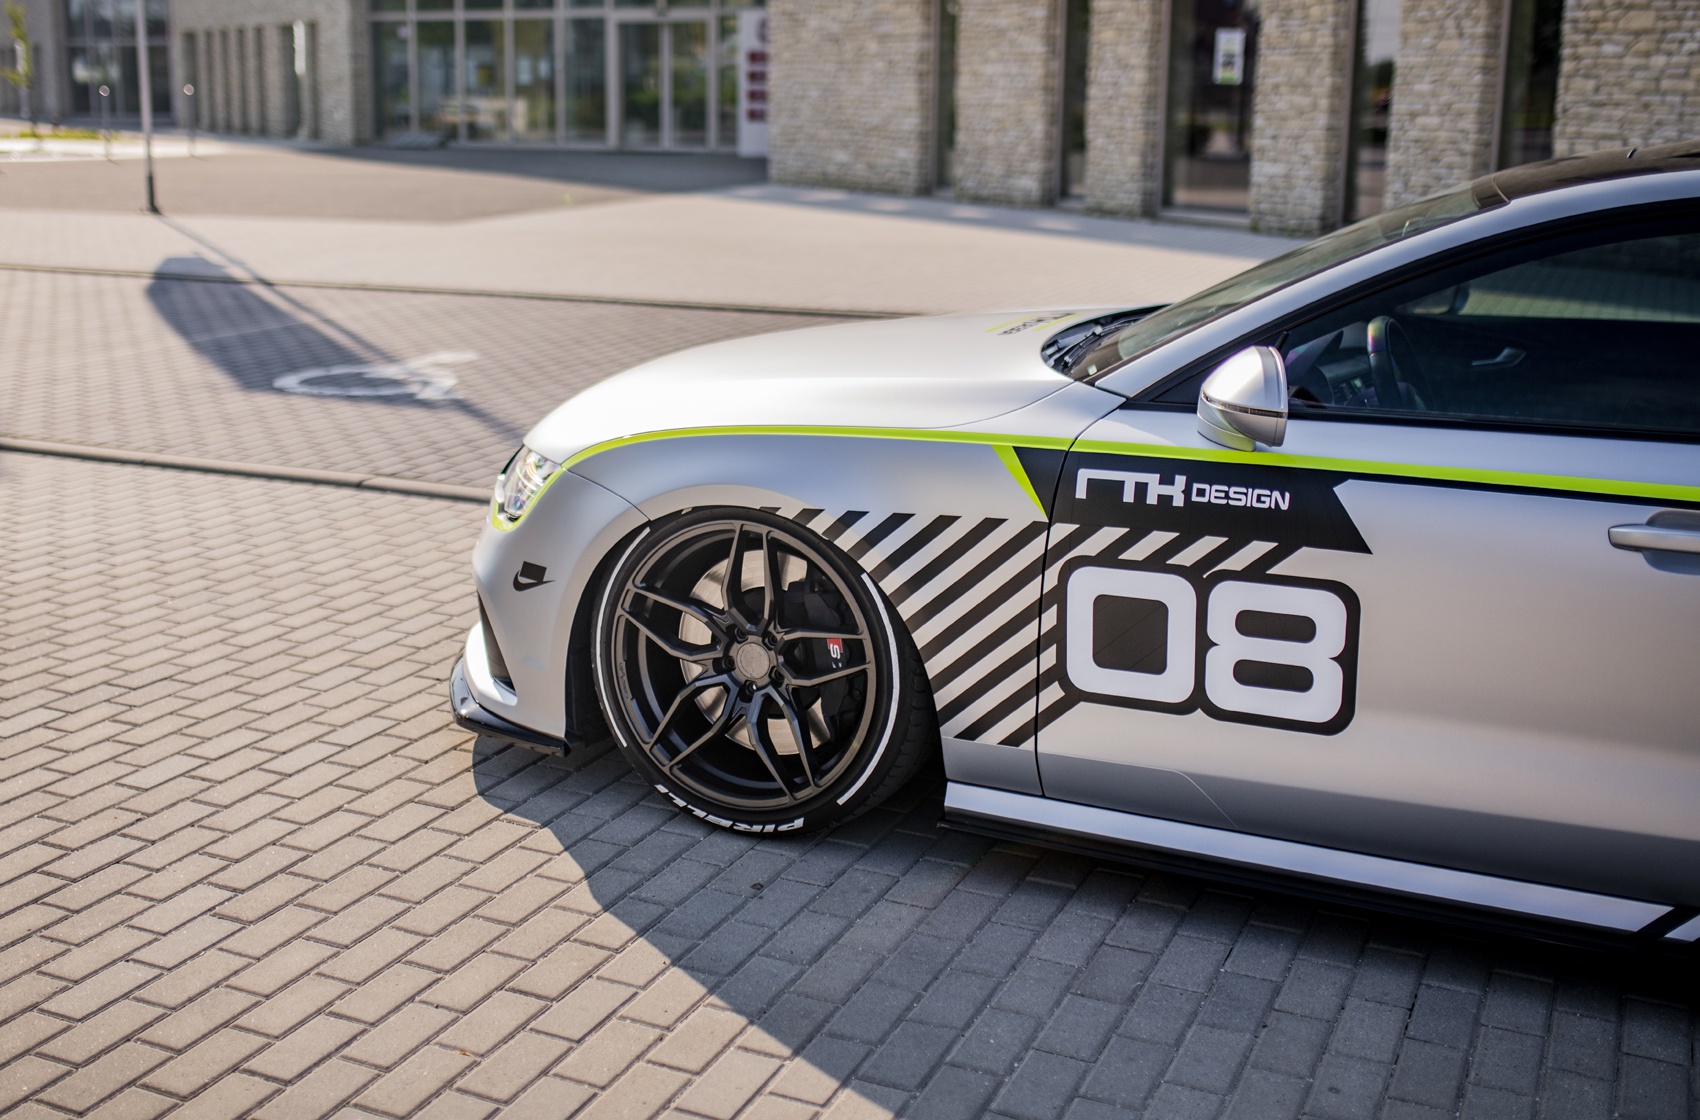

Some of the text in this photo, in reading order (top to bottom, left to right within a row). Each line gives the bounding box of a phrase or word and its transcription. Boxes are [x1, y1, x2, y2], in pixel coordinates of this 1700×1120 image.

[1191, 482, 1291, 511] DESIGN
[1066, 566, 1347, 723] 08
[654, 784, 804, 833] PIRELLI
